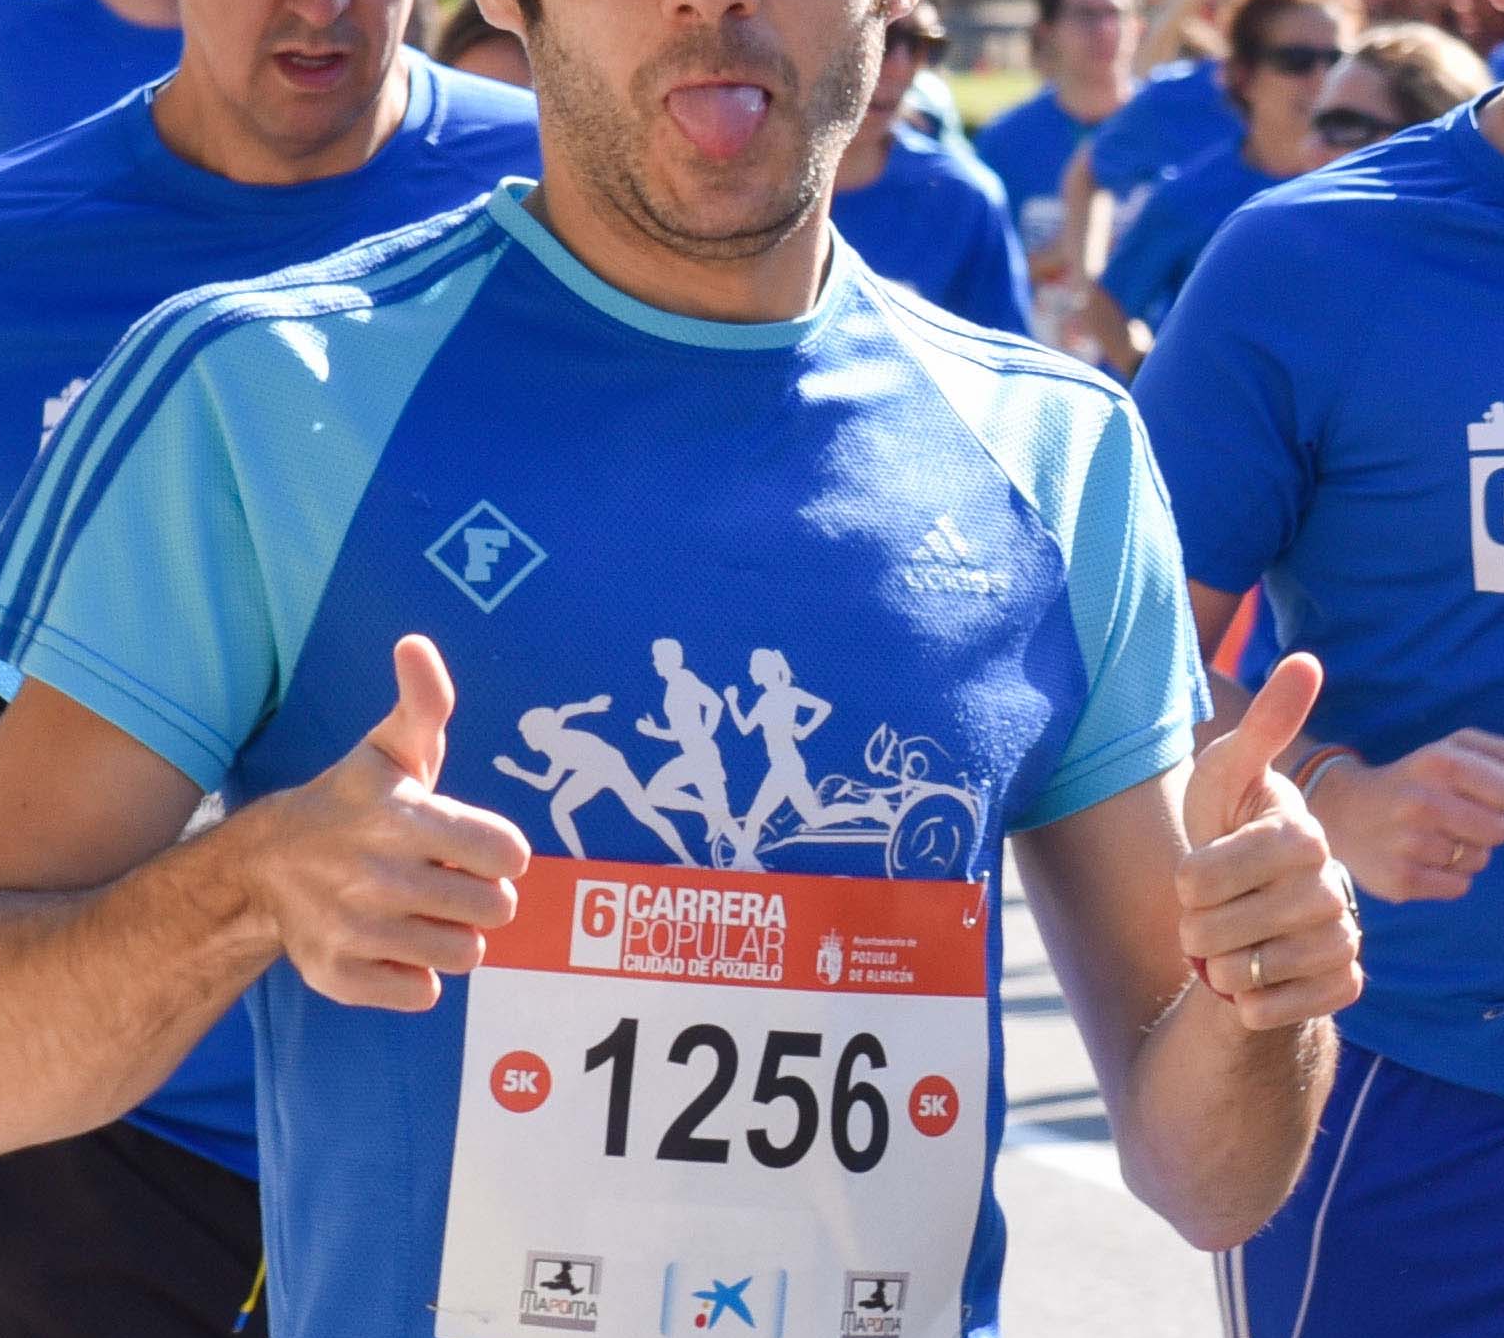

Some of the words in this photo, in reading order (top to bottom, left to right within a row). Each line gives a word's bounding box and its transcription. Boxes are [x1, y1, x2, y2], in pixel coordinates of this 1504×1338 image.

[465, 528, 509, 581] F
[582, 888, 617, 938] 6
[628, 884, 787, 929] CARRERA
[625, 917, 785, 963] POPULAR
[850, 950, 897, 965] POZUELO
[623, 954, 684, 975] CIUDAD
[688, 959, 709, 978] DE
[712, 960, 783, 981] POZUELO
[849, 968, 864, 982] DE
[502, 1069, 539, 1094] 5K
[584, 1017, 889, 1173] 1256
[917, 1094, 948, 1118] 5K
